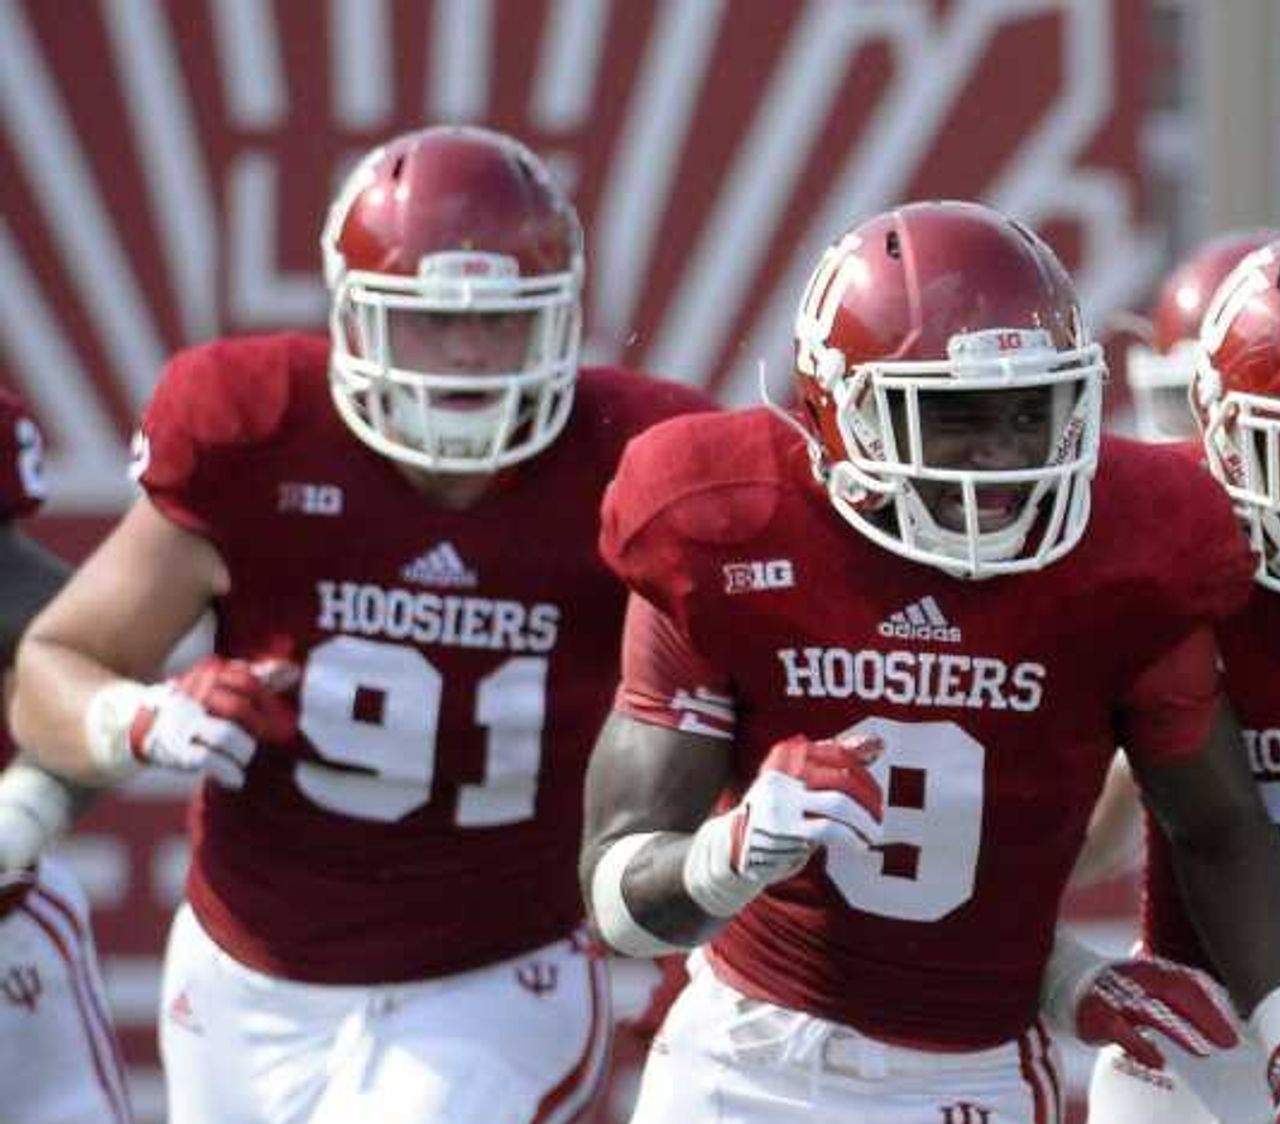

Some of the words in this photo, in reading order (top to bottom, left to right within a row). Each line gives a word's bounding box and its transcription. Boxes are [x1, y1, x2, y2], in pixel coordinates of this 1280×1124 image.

[315, 578, 562, 652] HOOSIERS
[876, 620, 962, 643] adidas
[777, 646, 1048, 713] HOOSIERS
[294, 634, 550, 828] 91
